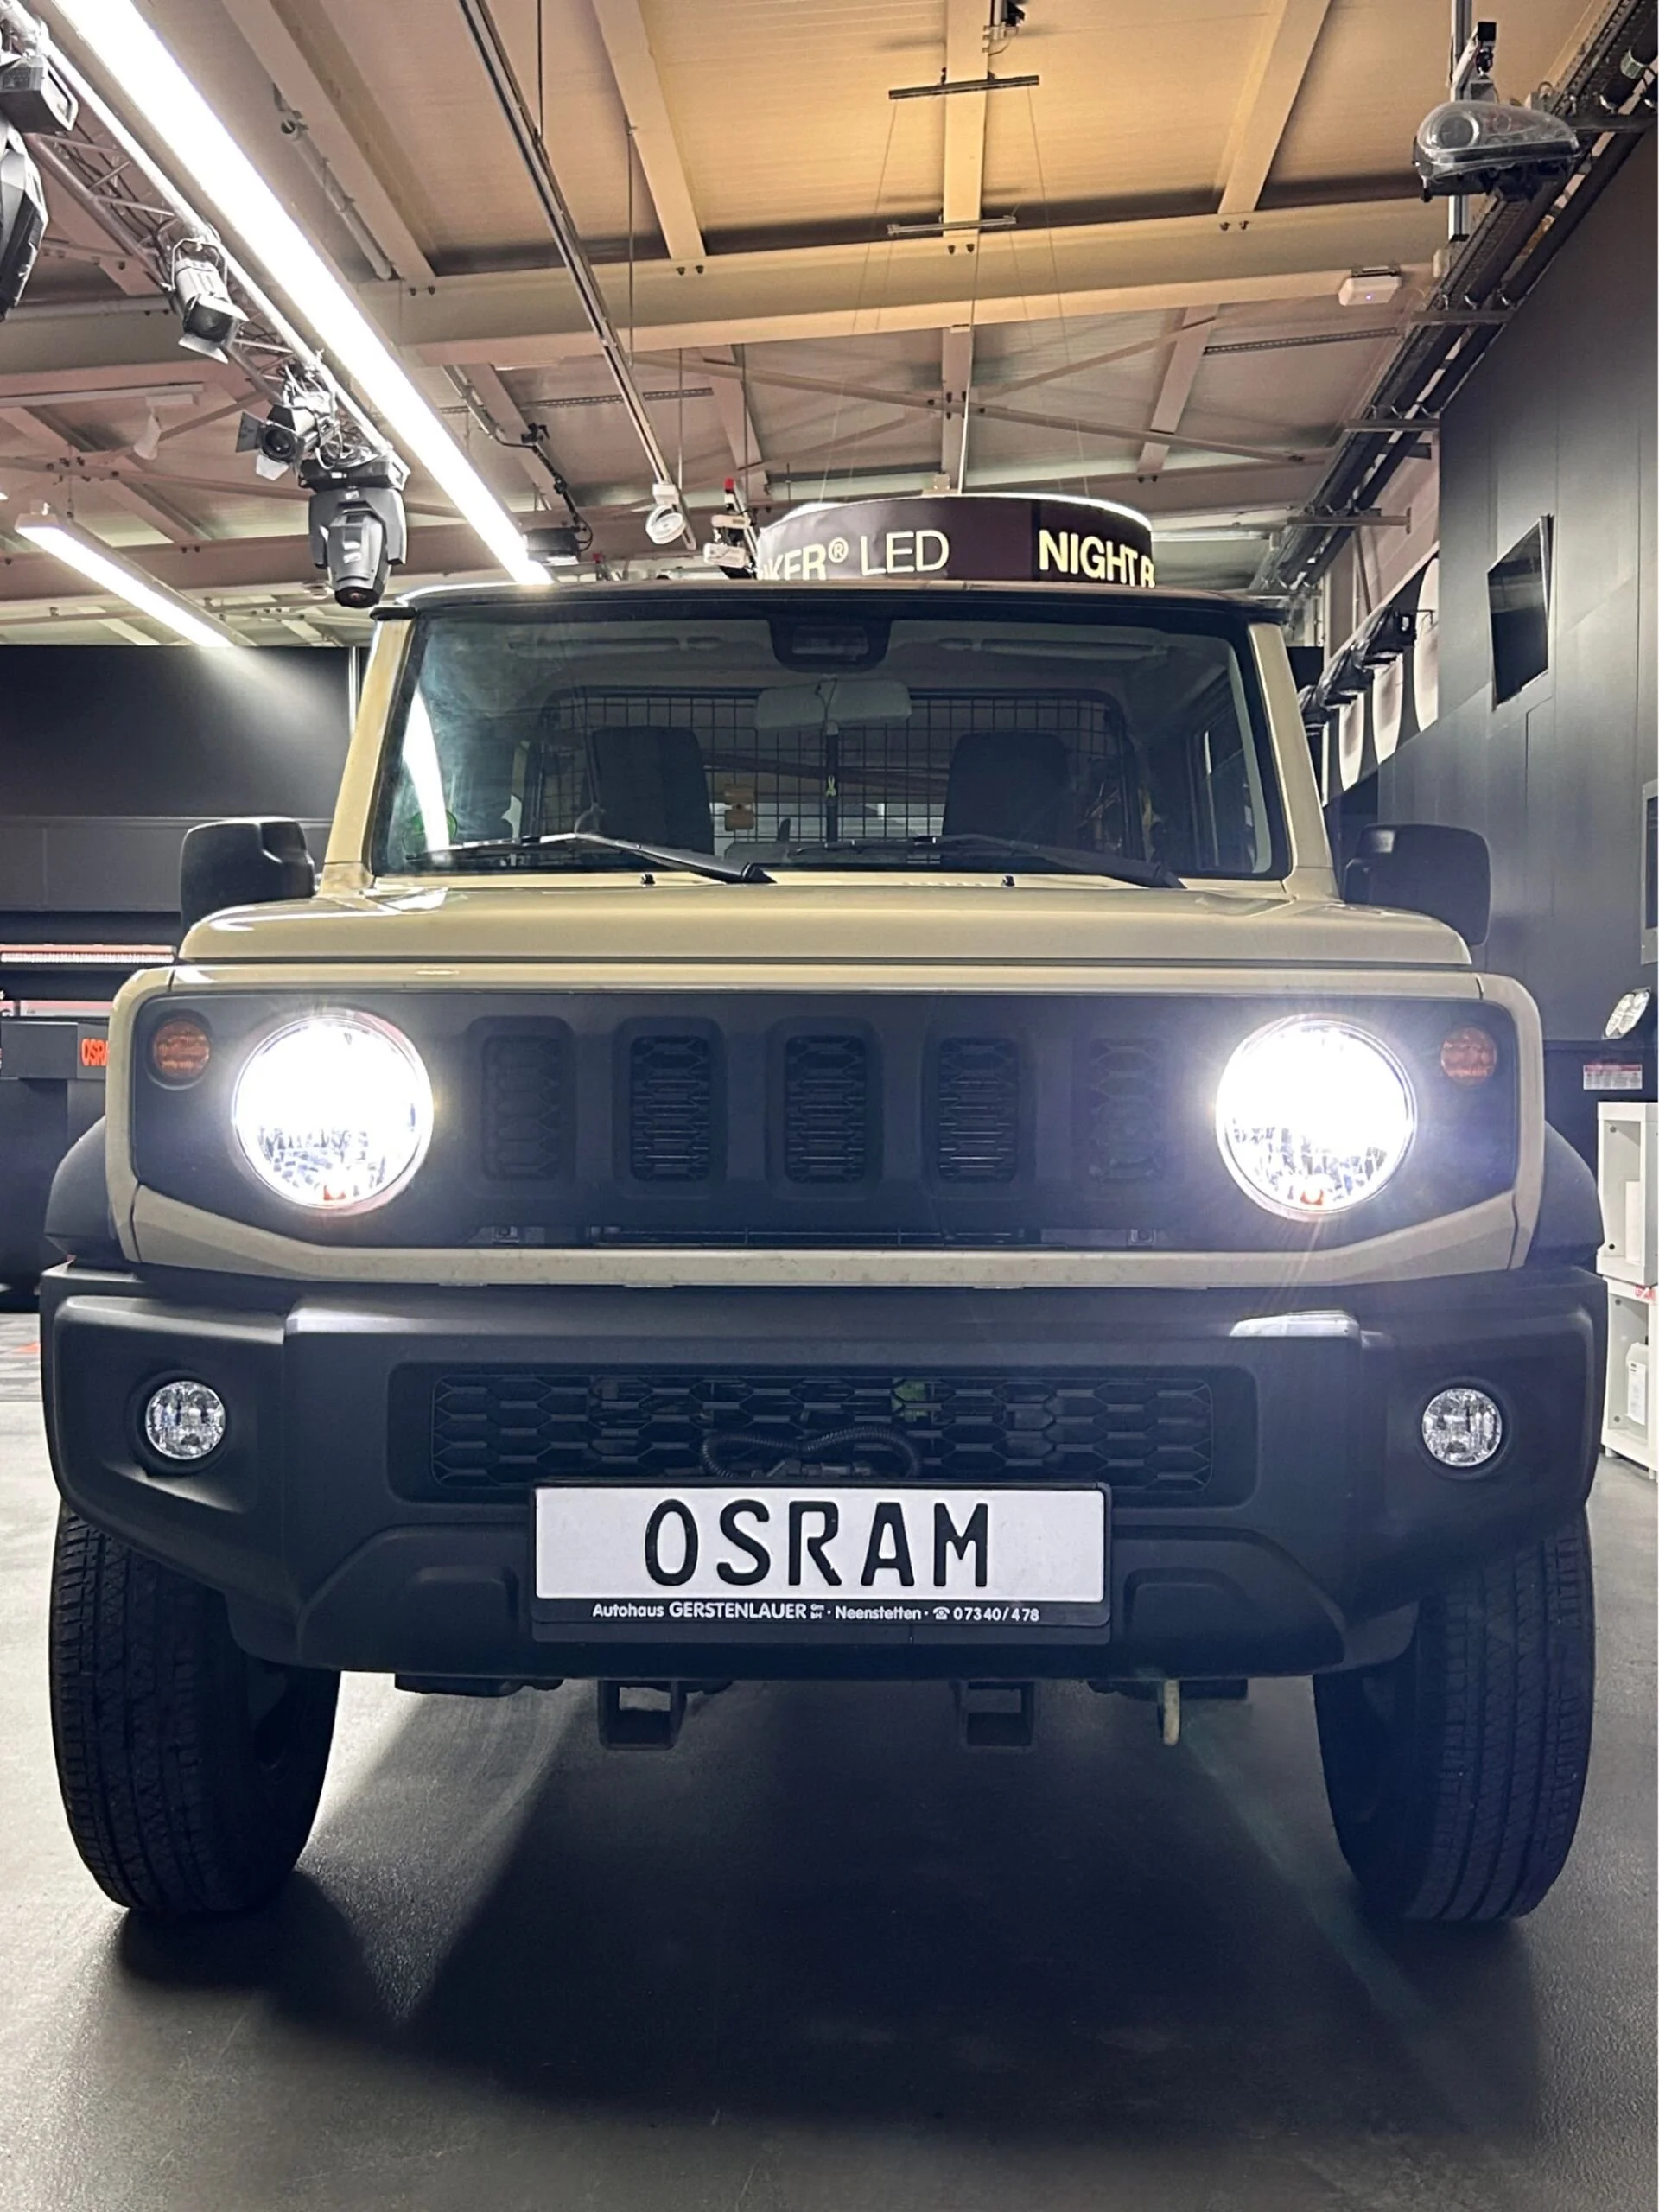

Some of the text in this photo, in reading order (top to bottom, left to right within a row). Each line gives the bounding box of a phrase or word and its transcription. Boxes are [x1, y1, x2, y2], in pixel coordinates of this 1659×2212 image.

[860, 529, 950, 576] LED
[1039, 529, 1138, 588] NIGHT
[81, 1039, 110, 1066] OSR
[645, 1499, 988, 1587] OSRAM
[592, 1603, 664, 1618] Autohaus
[669, 1601, 807, 1619] GERSTENLAUER
[835, 1605, 922, 1620] Neenstetten
